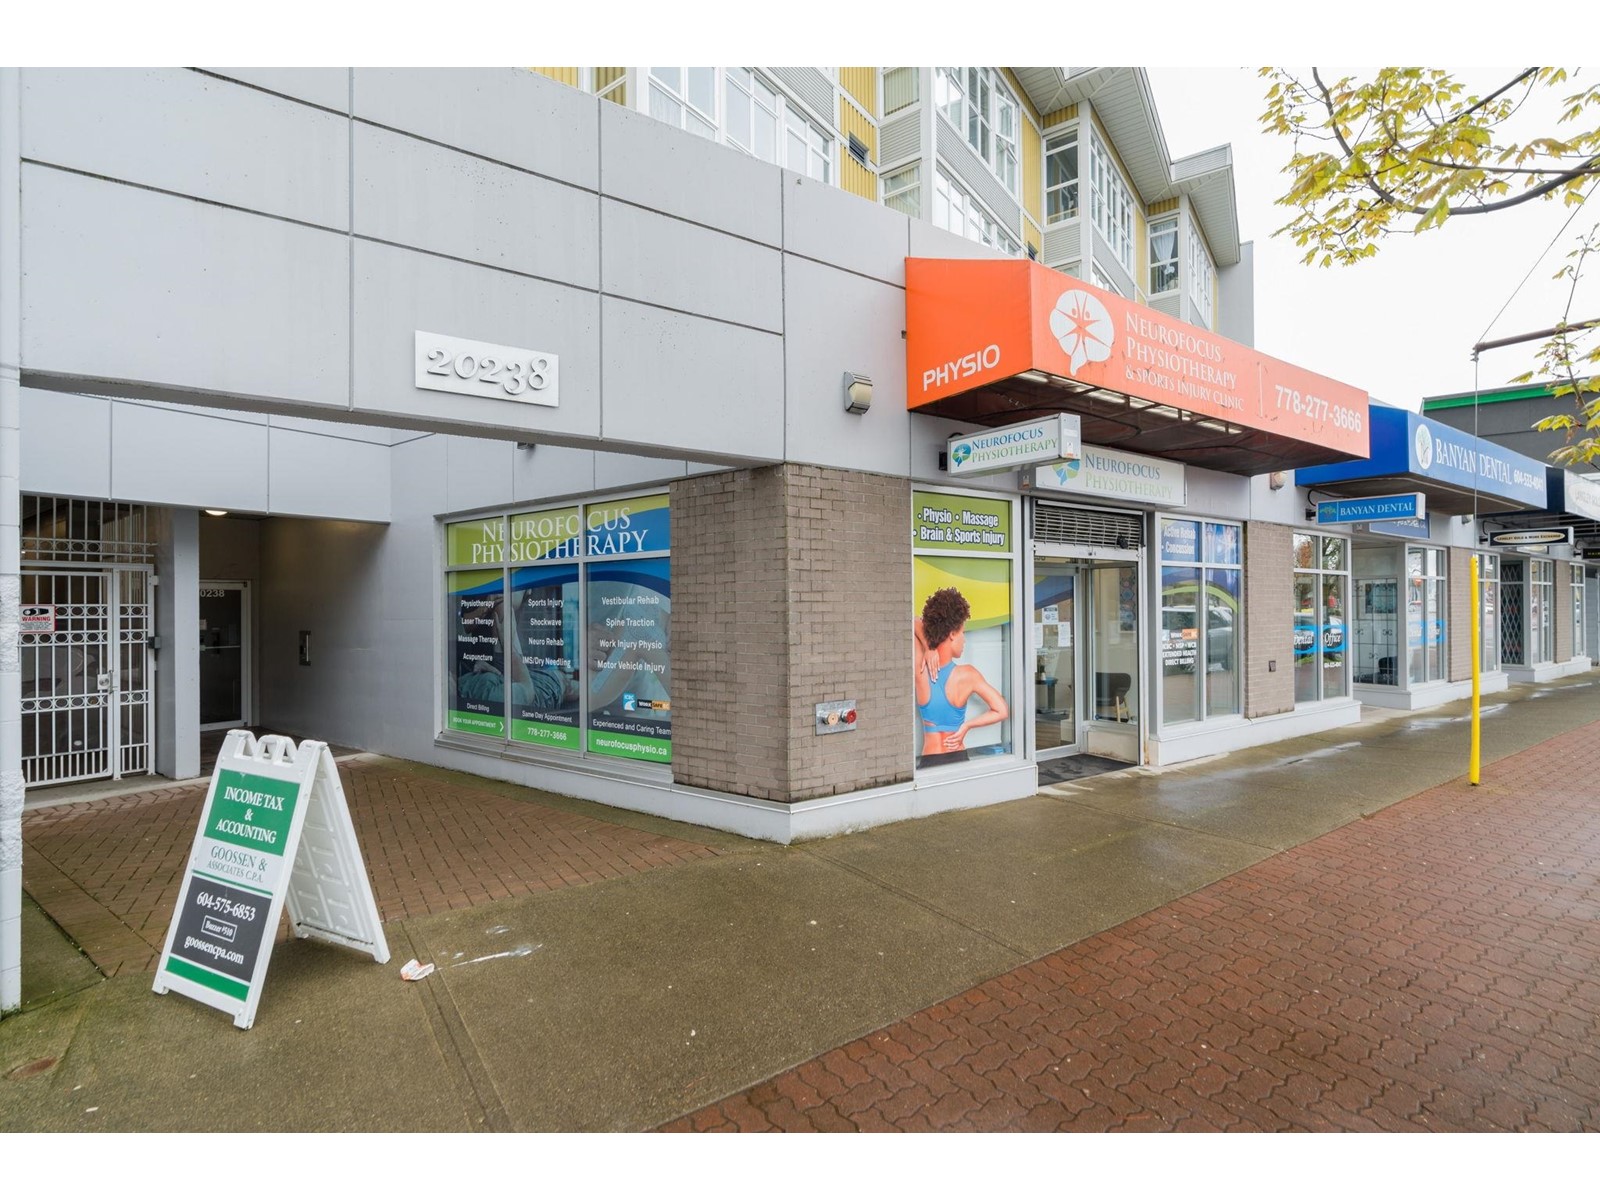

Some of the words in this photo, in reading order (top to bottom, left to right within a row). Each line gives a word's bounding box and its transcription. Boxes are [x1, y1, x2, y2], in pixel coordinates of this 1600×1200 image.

[1126, 311, 1221, 362] NEUROFOCUS
[427, 347, 550, 395] 20238
[923, 344, 1000, 392] PHYSIO
[1126, 336, 1237, 390] PHYSIOTHERAPY
[1125, 365, 1134, 379] &
[1136, 367, 1175, 392] SPORTS
[1177, 379, 1212, 401] INJURY
[1213, 390, 1245, 412] CLINIC
[1275, 384, 1362, 433] 778-277-3666
[971, 427, 1044, 450] NEUROFOCUS
[972, 438, 1058, 463] PHYSIOTHERAPY
[1085, 453, 1160, 480] NEUROFOCUS
[1435, 439, 1477, 473] BANYAN
[1479, 453, 1513, 486] DENTAL
[1085, 472, 1173, 500] PHYSIOTHERAPY
[923, 507, 952, 524] Physio
[962, 510, 999, 528] Massage
[1340, 504, 1375, 516] BANYAN
[1377, 502, 1415, 513] DENTAL
[482, 507, 631, 543] NEUROFOCUS
[920, 526, 944, 541] Brain
[946, 527, 953, 542] &
[955, 528, 981, 544] Sports
[982, 530, 1005, 546] Injury
[472, 529, 648, 564] PHYSIOTHERAPY
[200, 589, 225, 598] 0238
[601, 596, 636, 606] Vestibular
[637, 596, 660, 605] Rehab
[461, 600, 495, 609] Physiotherapy
[528, 599, 547, 608] Sports
[547, 598, 565, 608] Injury
[461, 618, 475, 626] Laser
[475, 617, 495, 627] Therapy
[530, 617, 562, 626] Shockwave
[605, 618, 625, 629] Spine
[626, 618, 655, 627] Traction
[458, 635, 478, 645] Massage
[479, 635, 498, 646] Therapy
[528, 637, 545, 646] Neuro
[546, 637, 565, 647] Rehab
[600, 639, 617, 648] Work
[617, 640, 638, 651] Injury
[638, 640, 663, 651] Physio
[1324, 632, 1342, 647] Office
[463, 653, 493, 662] Acupuncture
[522, 656, 545, 667] IMS/Dry
[545, 657, 571, 669] Needling
[597, 660, 617, 669] Motor
[618, 660, 643, 671] Vehicle
[644, 662, 666, 675] Injury
[466, 702, 478, 710] Direct
[478, 704, 490, 712] Billing
[522, 710, 534, 719] Same
[534, 711, 544, 721] Day
[544, 713, 573, 723] Appointment
[527, 727, 567, 741] 778-277-3666
[592, 718, 624, 730] Experienced
[625, 723, 636, 731] and
[636, 724, 655, 735] Caring
[655, 726, 672, 736] Team
[596, 738, 668, 756] neurofocusphysio.ca
[223, 786, 264, 807] INCOME
[263, 793, 285, 812] TAX
[244, 808, 254, 822] &
[215, 818, 277, 844] ACCOUNTING
[210, 845, 257, 869] GOOSSEN
[258, 857, 268, 873] &
[207, 860, 244, 878] ASSOCIATES
[196, 891, 257, 922] 604-575-6853
[205, 920, 222, 933] Buzzer
[183, 935, 245, 965] goossencpa.com
